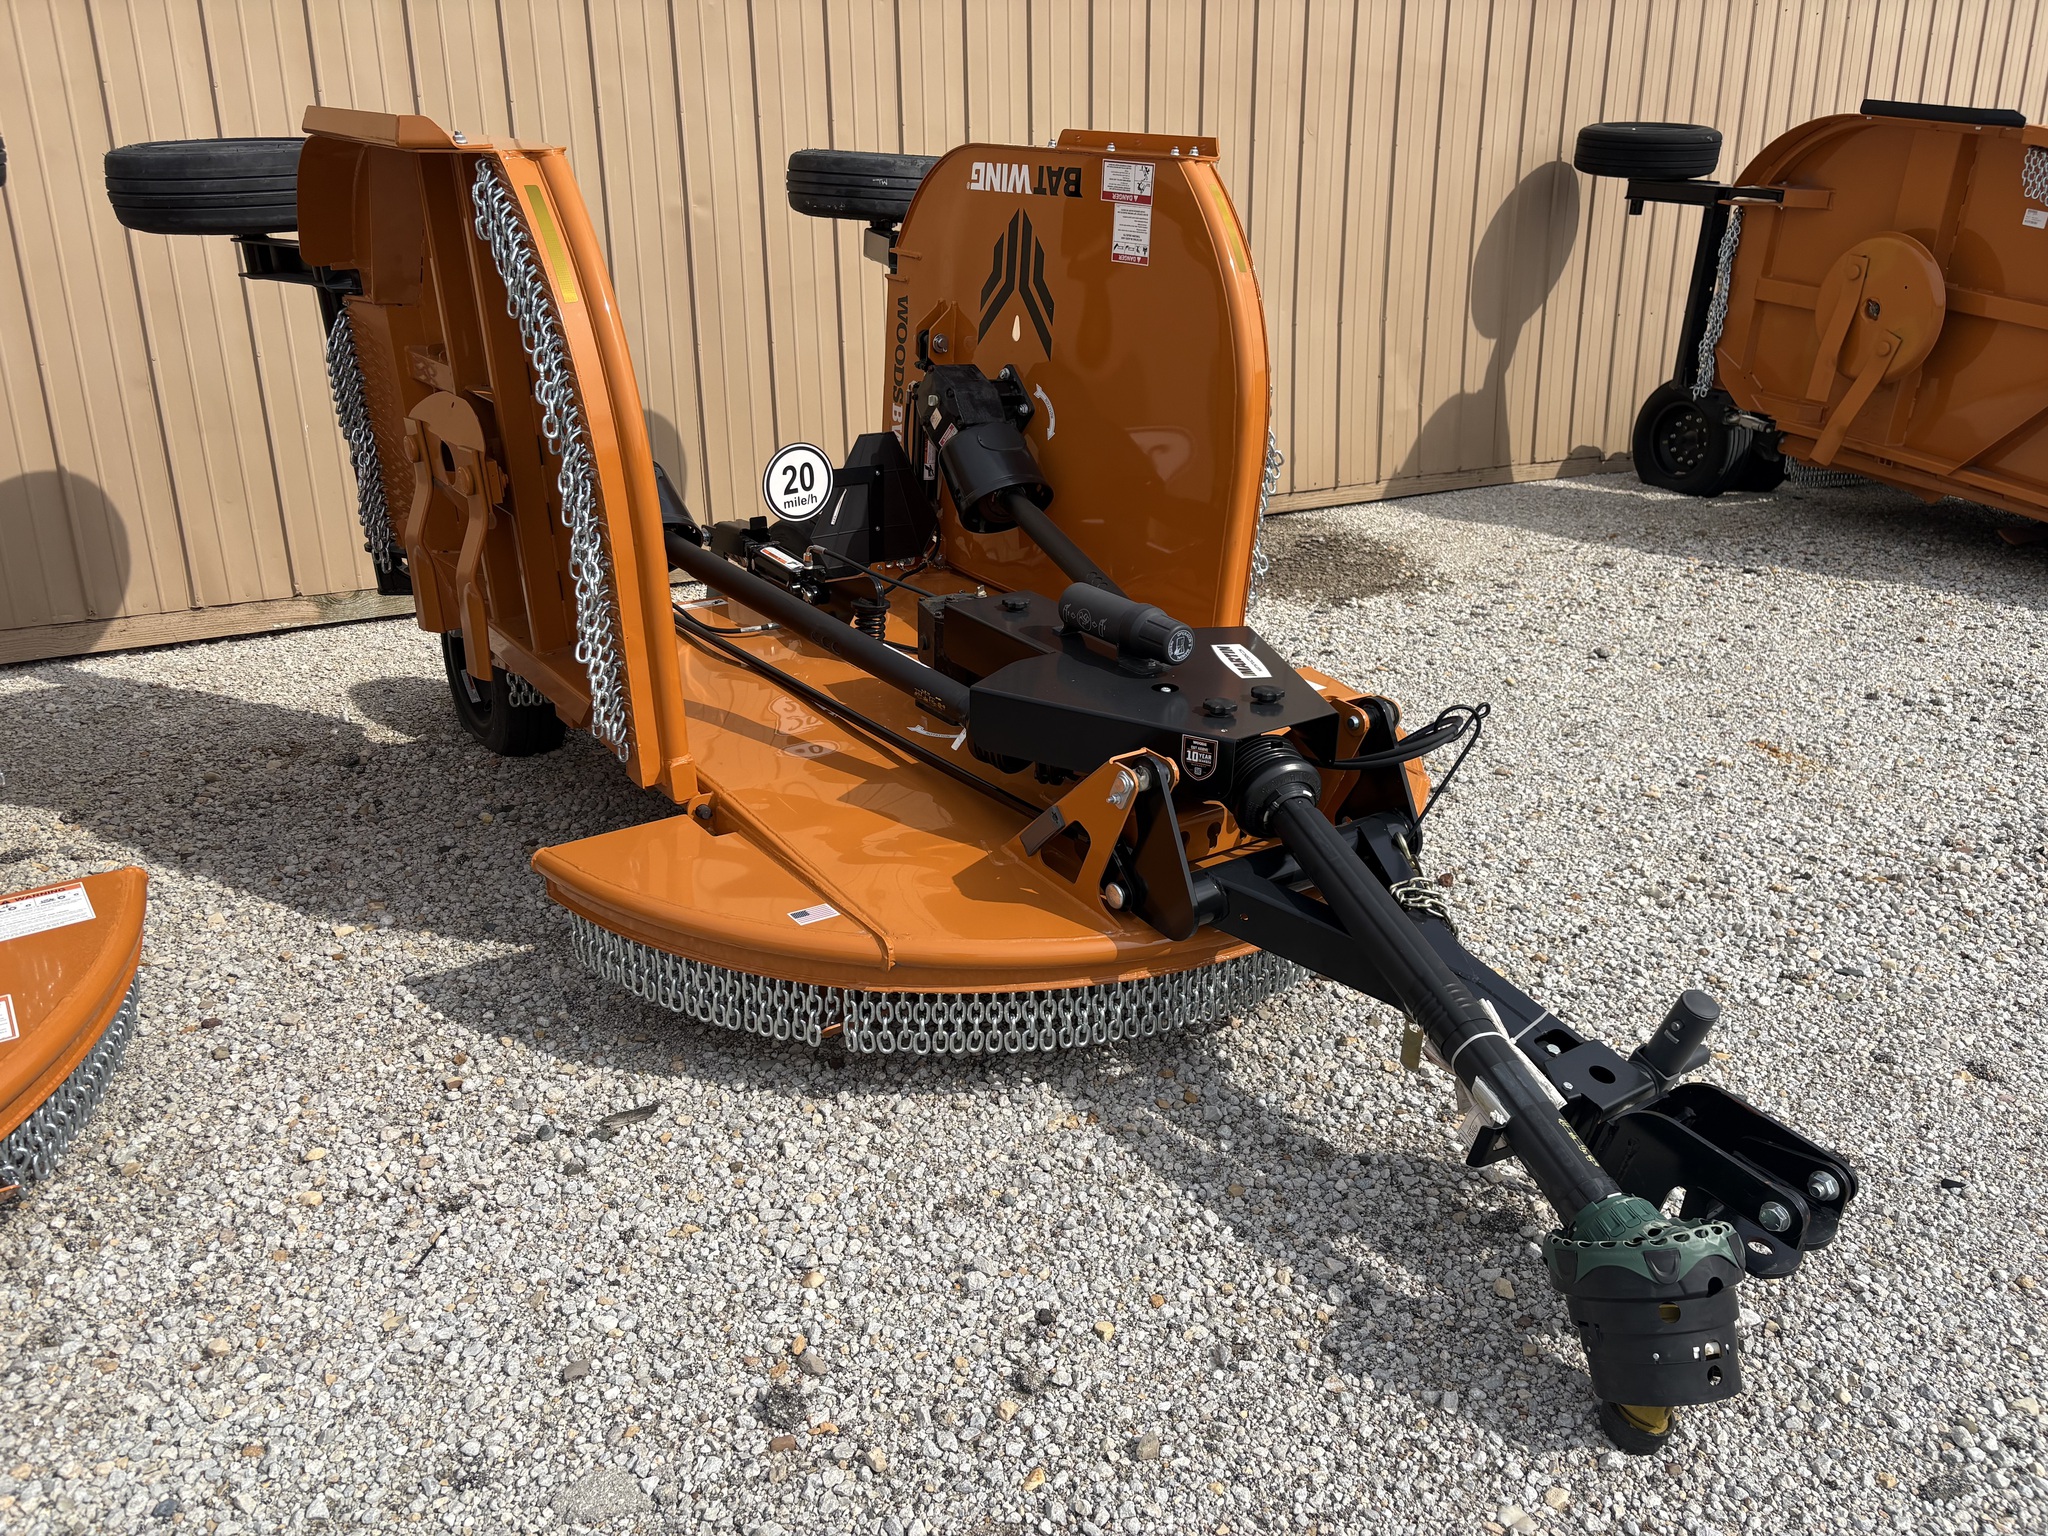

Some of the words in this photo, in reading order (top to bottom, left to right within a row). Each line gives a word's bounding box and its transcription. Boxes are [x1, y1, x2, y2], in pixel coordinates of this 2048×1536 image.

[970, 161, 1083, 198] BATWING
[1111, 192, 1133, 202] DANGER
[1118, 254, 1137, 263] DANGER
[782, 462, 814, 495] 20
[784, 494, 818, 509] mile/h
[1186, 750, 1199, 762] 10
[14, 887, 66, 902] WARNING
